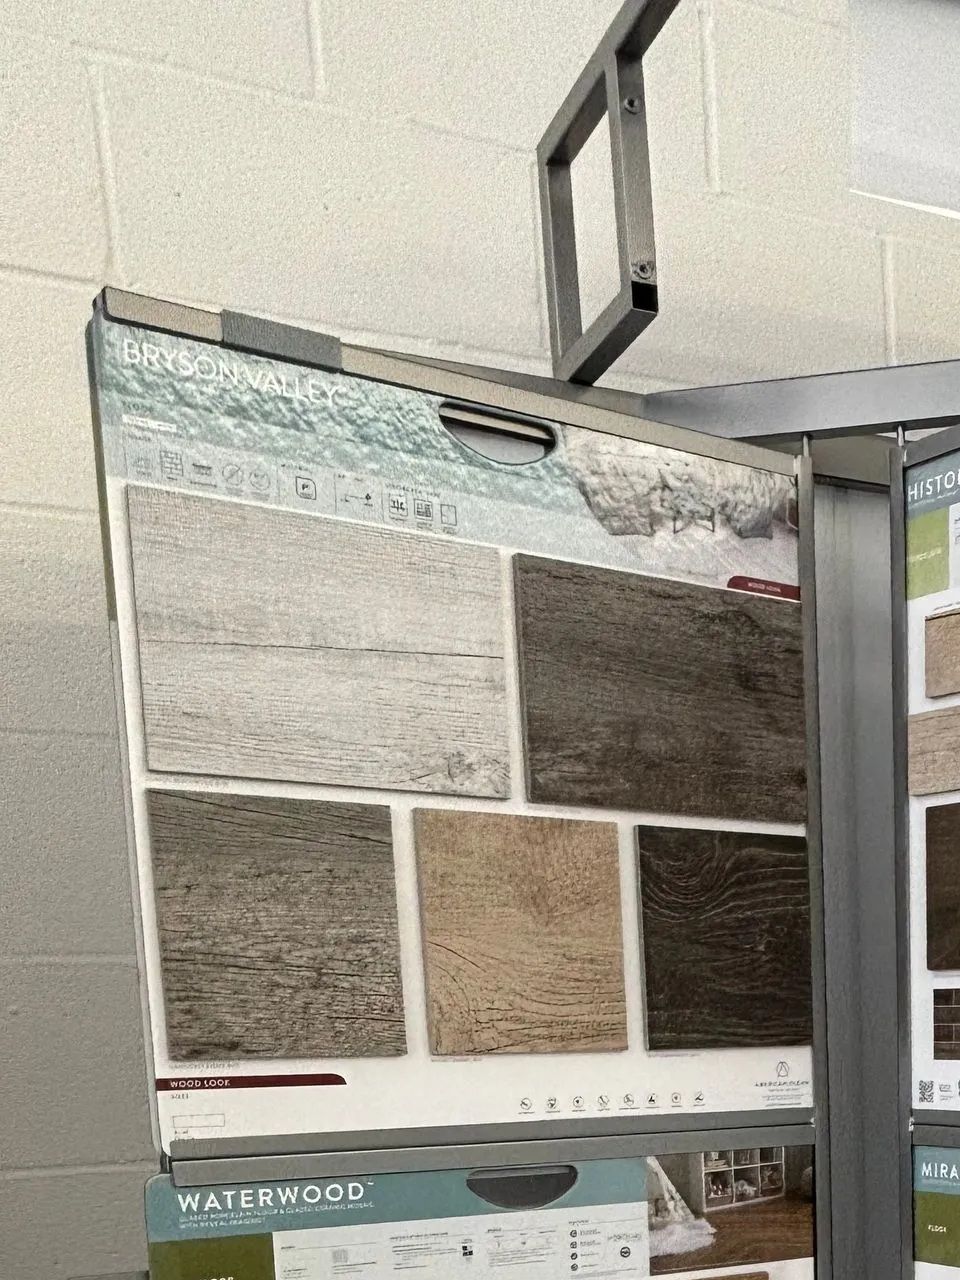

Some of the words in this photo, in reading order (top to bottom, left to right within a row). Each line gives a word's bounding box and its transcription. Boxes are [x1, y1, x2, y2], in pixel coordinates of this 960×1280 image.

[123, 338, 239, 387] BRYSON
[169, 1079, 201, 1089] WOOD
[177, 1182, 365, 1213] WATERWOOD
